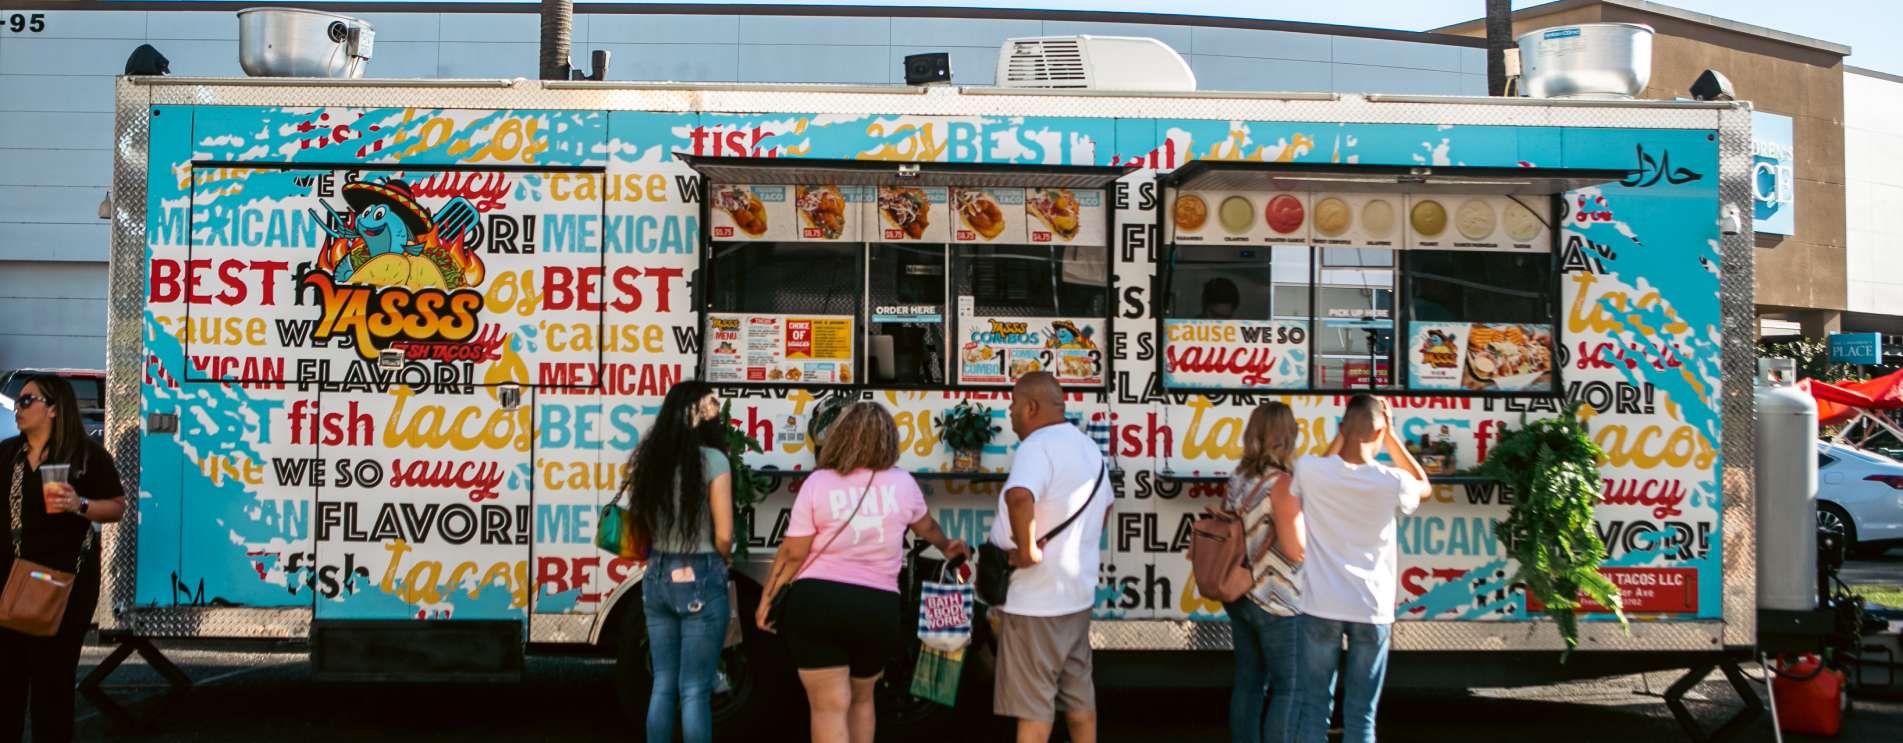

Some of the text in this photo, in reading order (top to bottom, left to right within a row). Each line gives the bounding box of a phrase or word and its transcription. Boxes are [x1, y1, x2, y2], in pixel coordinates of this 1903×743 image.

[1620, 143, 1703, 187] حلال
[400, 170, 512, 213] aucy
[675, 175, 700, 203] W
[149, 258, 289, 306] BEST
[542, 265, 683, 313] BEST
[301, 270, 482, 360] YASSS
[876, 306, 936, 314] ORDER HERE
[1328, 309, 1350, 317] PICK
[1350, 309, 1363, 317] UP
[672, 326, 699, 354] W
[792, 330, 807, 340] OF
[970, 331, 1041, 345] COMBOS
[1240, 327, 1272, 343] WE
[1277, 327, 1306, 344] SO
[432, 344, 482, 359] TACOS
[991, 349, 1005, 375] 1
[1088, 350, 1102, 376] 3
[1166, 345, 1276, 386] saucy
[1832, 345, 1873, 357] PLACE
[145, 356, 474, 395] XICAN FLAVOR!
[539, 363, 682, 396] MEXICAN
[288, 400, 374, 446] fish
[272, 458, 326, 488] WE
[335, 458, 384, 489] SO
[389, 458, 505, 502] saucy
[829, 484, 898, 520] PINK
[317, 501, 529, 545] FLAVOR!
[1398, 516, 1498, 556] XICAN
[1596, 521, 1710, 560] VOR!
[537, 556, 647, 603] BES
[1099, 563, 1171, 609] ish
[1616, 573, 1656, 585] TACOS
[1659, 574, 1683, 585] LLC
[1635, 588, 1654, 597] Ave
[925, 592, 962, 608] BATH
[934, 604, 963, 618] BODY
[926, 614, 967, 630] WORKS
